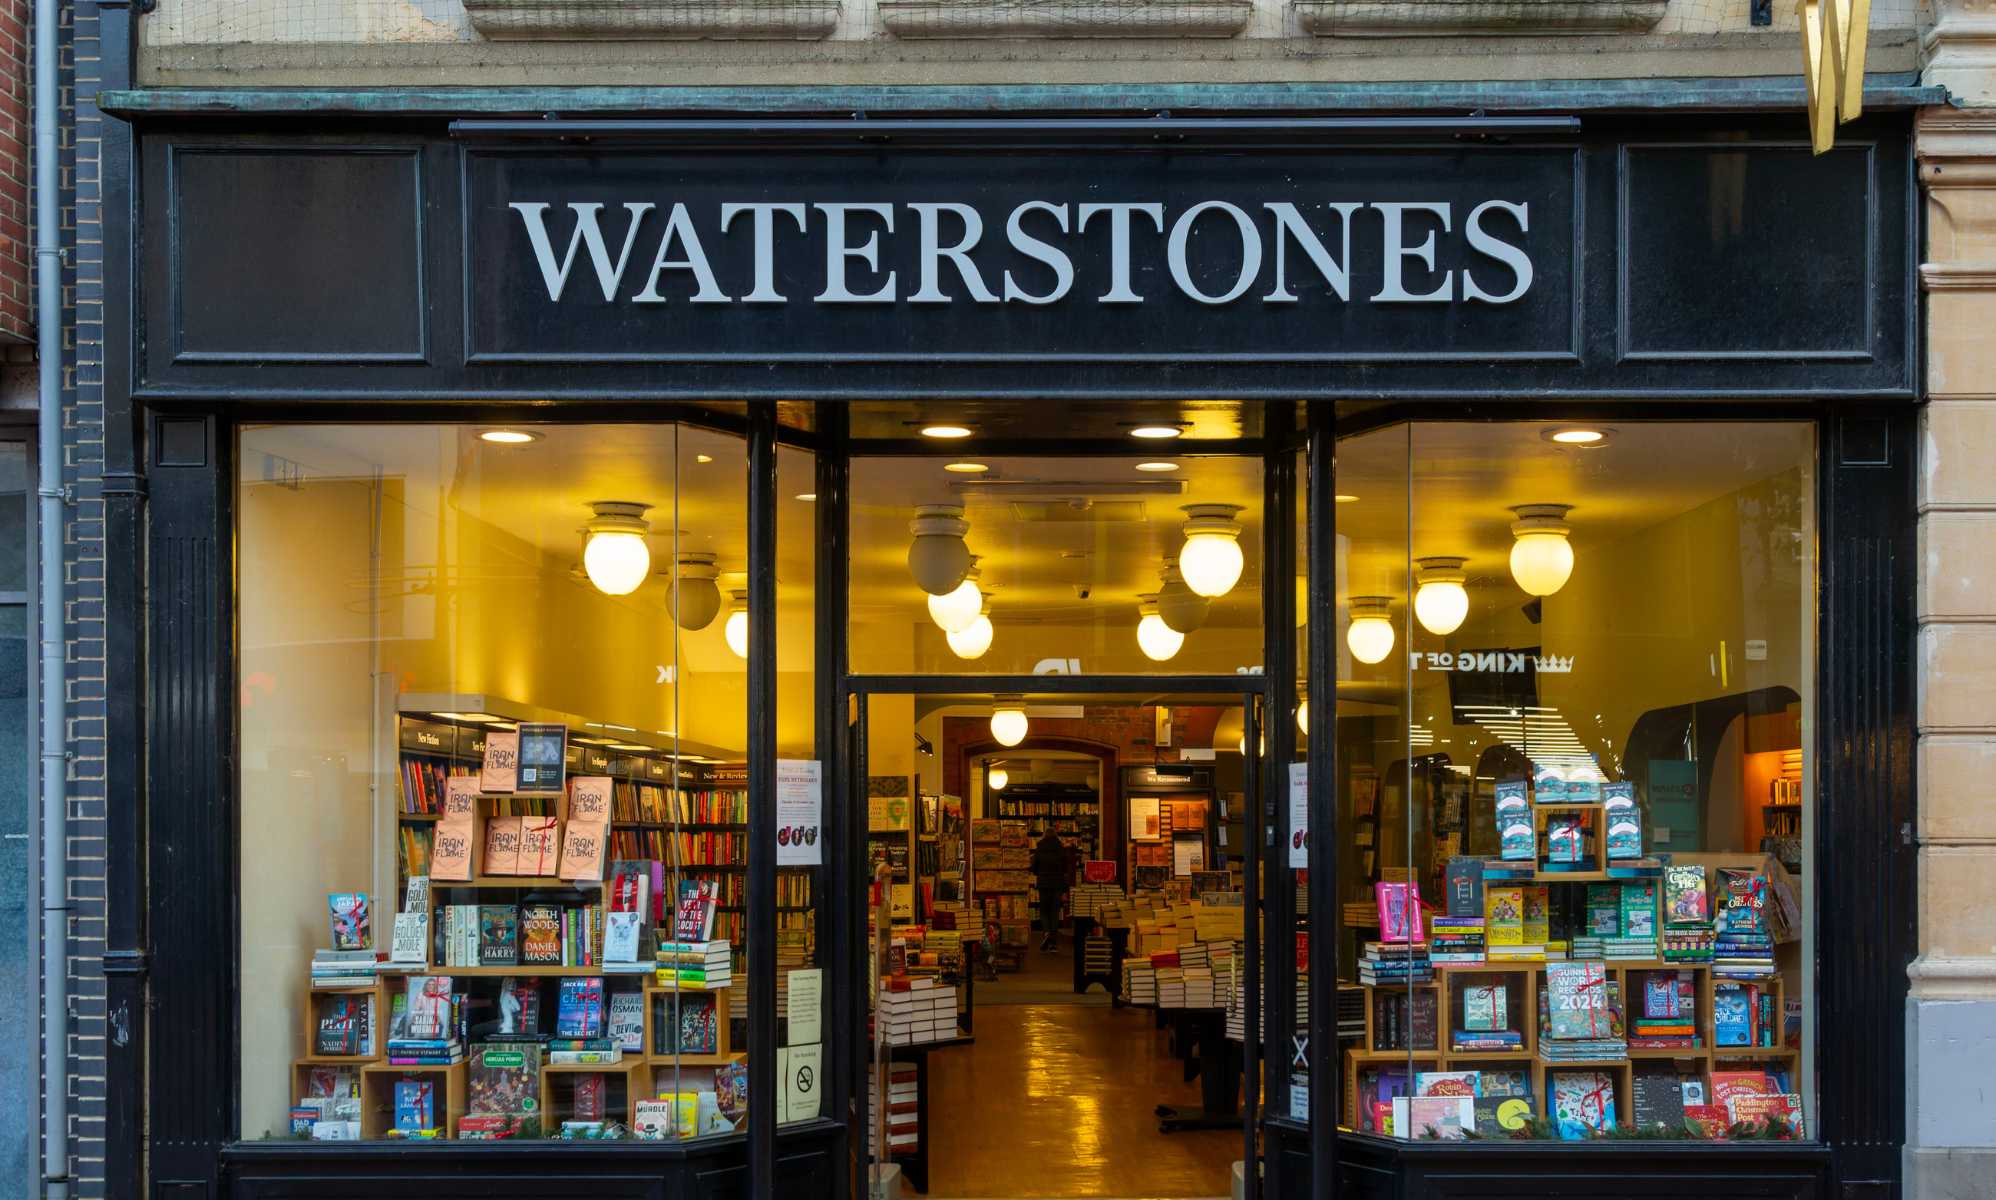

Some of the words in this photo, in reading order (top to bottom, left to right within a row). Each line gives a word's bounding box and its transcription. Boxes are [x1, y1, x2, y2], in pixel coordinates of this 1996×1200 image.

[509, 200, 1536, 306] WATERSTONES
[525, 909, 558, 919] NORTH
[523, 920, 560, 930] WOODS
[395, 926, 425, 939] GOLDEN
[525, 942, 558, 951] DANIEL
[484, 949, 515, 959] HARRY
[524, 952, 560, 961] MASON
[1560, 995, 1602, 1010] 2024
[612, 1005, 642, 1014] OSMAN
[636, 1105, 667, 1113] MURDLE
[1737, 1113, 1754, 1121] Post
